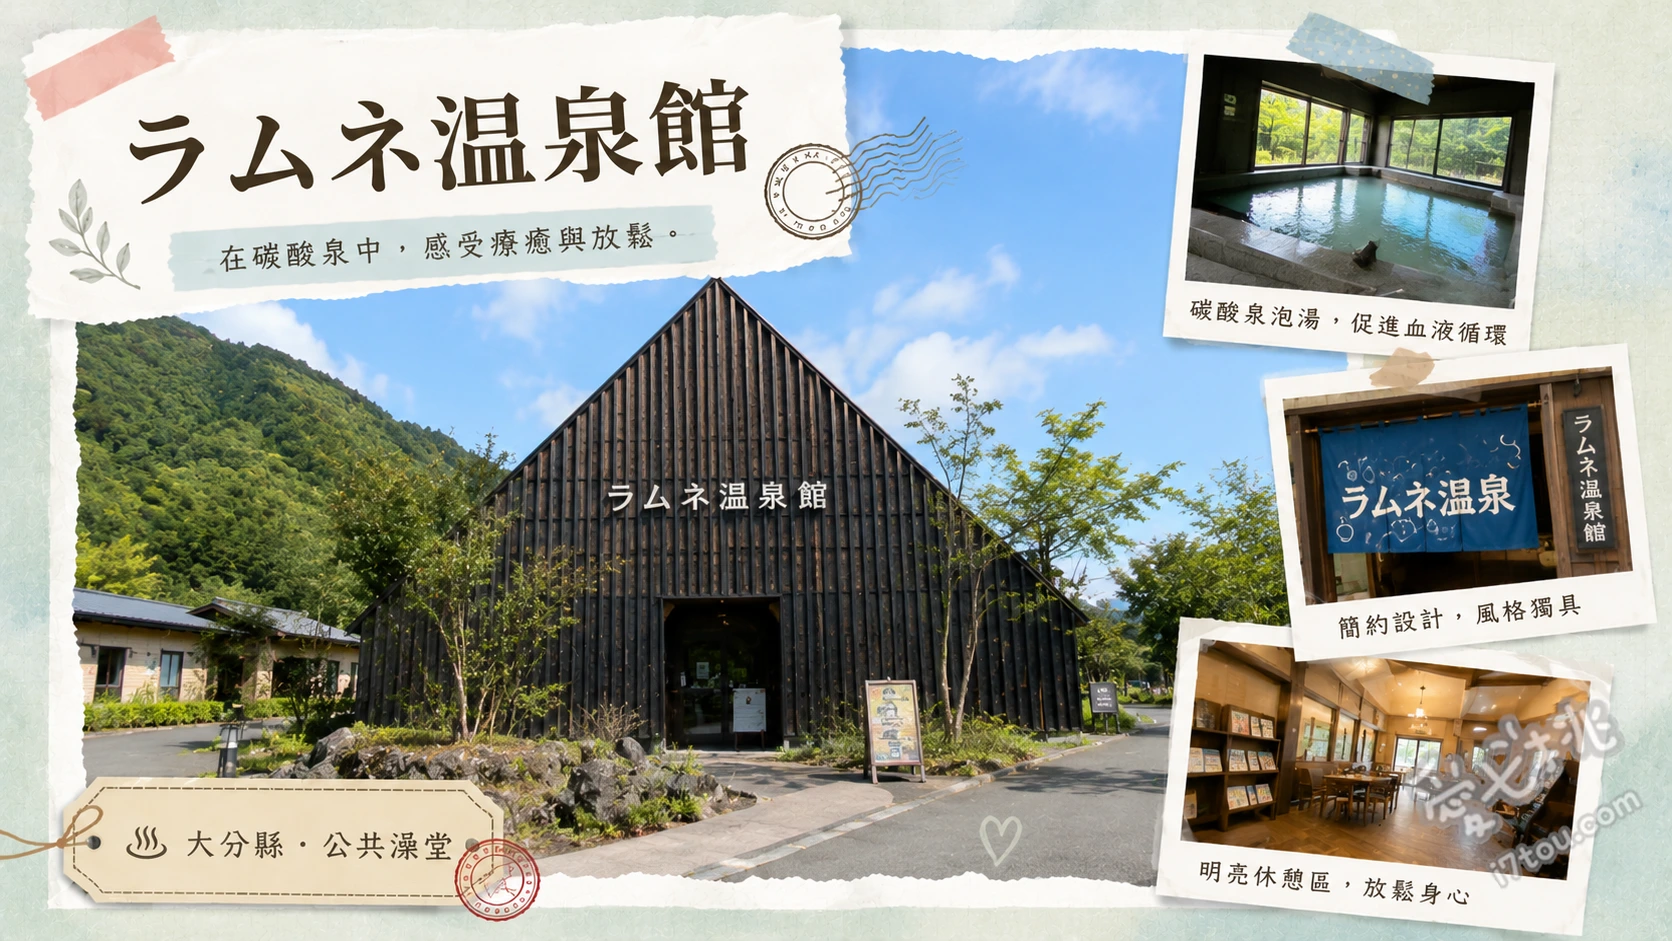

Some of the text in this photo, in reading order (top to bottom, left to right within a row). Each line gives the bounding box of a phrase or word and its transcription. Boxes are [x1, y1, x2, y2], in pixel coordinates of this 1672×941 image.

[608, 480, 827, 512] ラムネ温泉館
[1341, 473, 1517, 520] ラムネ温泉
[1574, 414, 1606, 543] ラムネ温泉館
